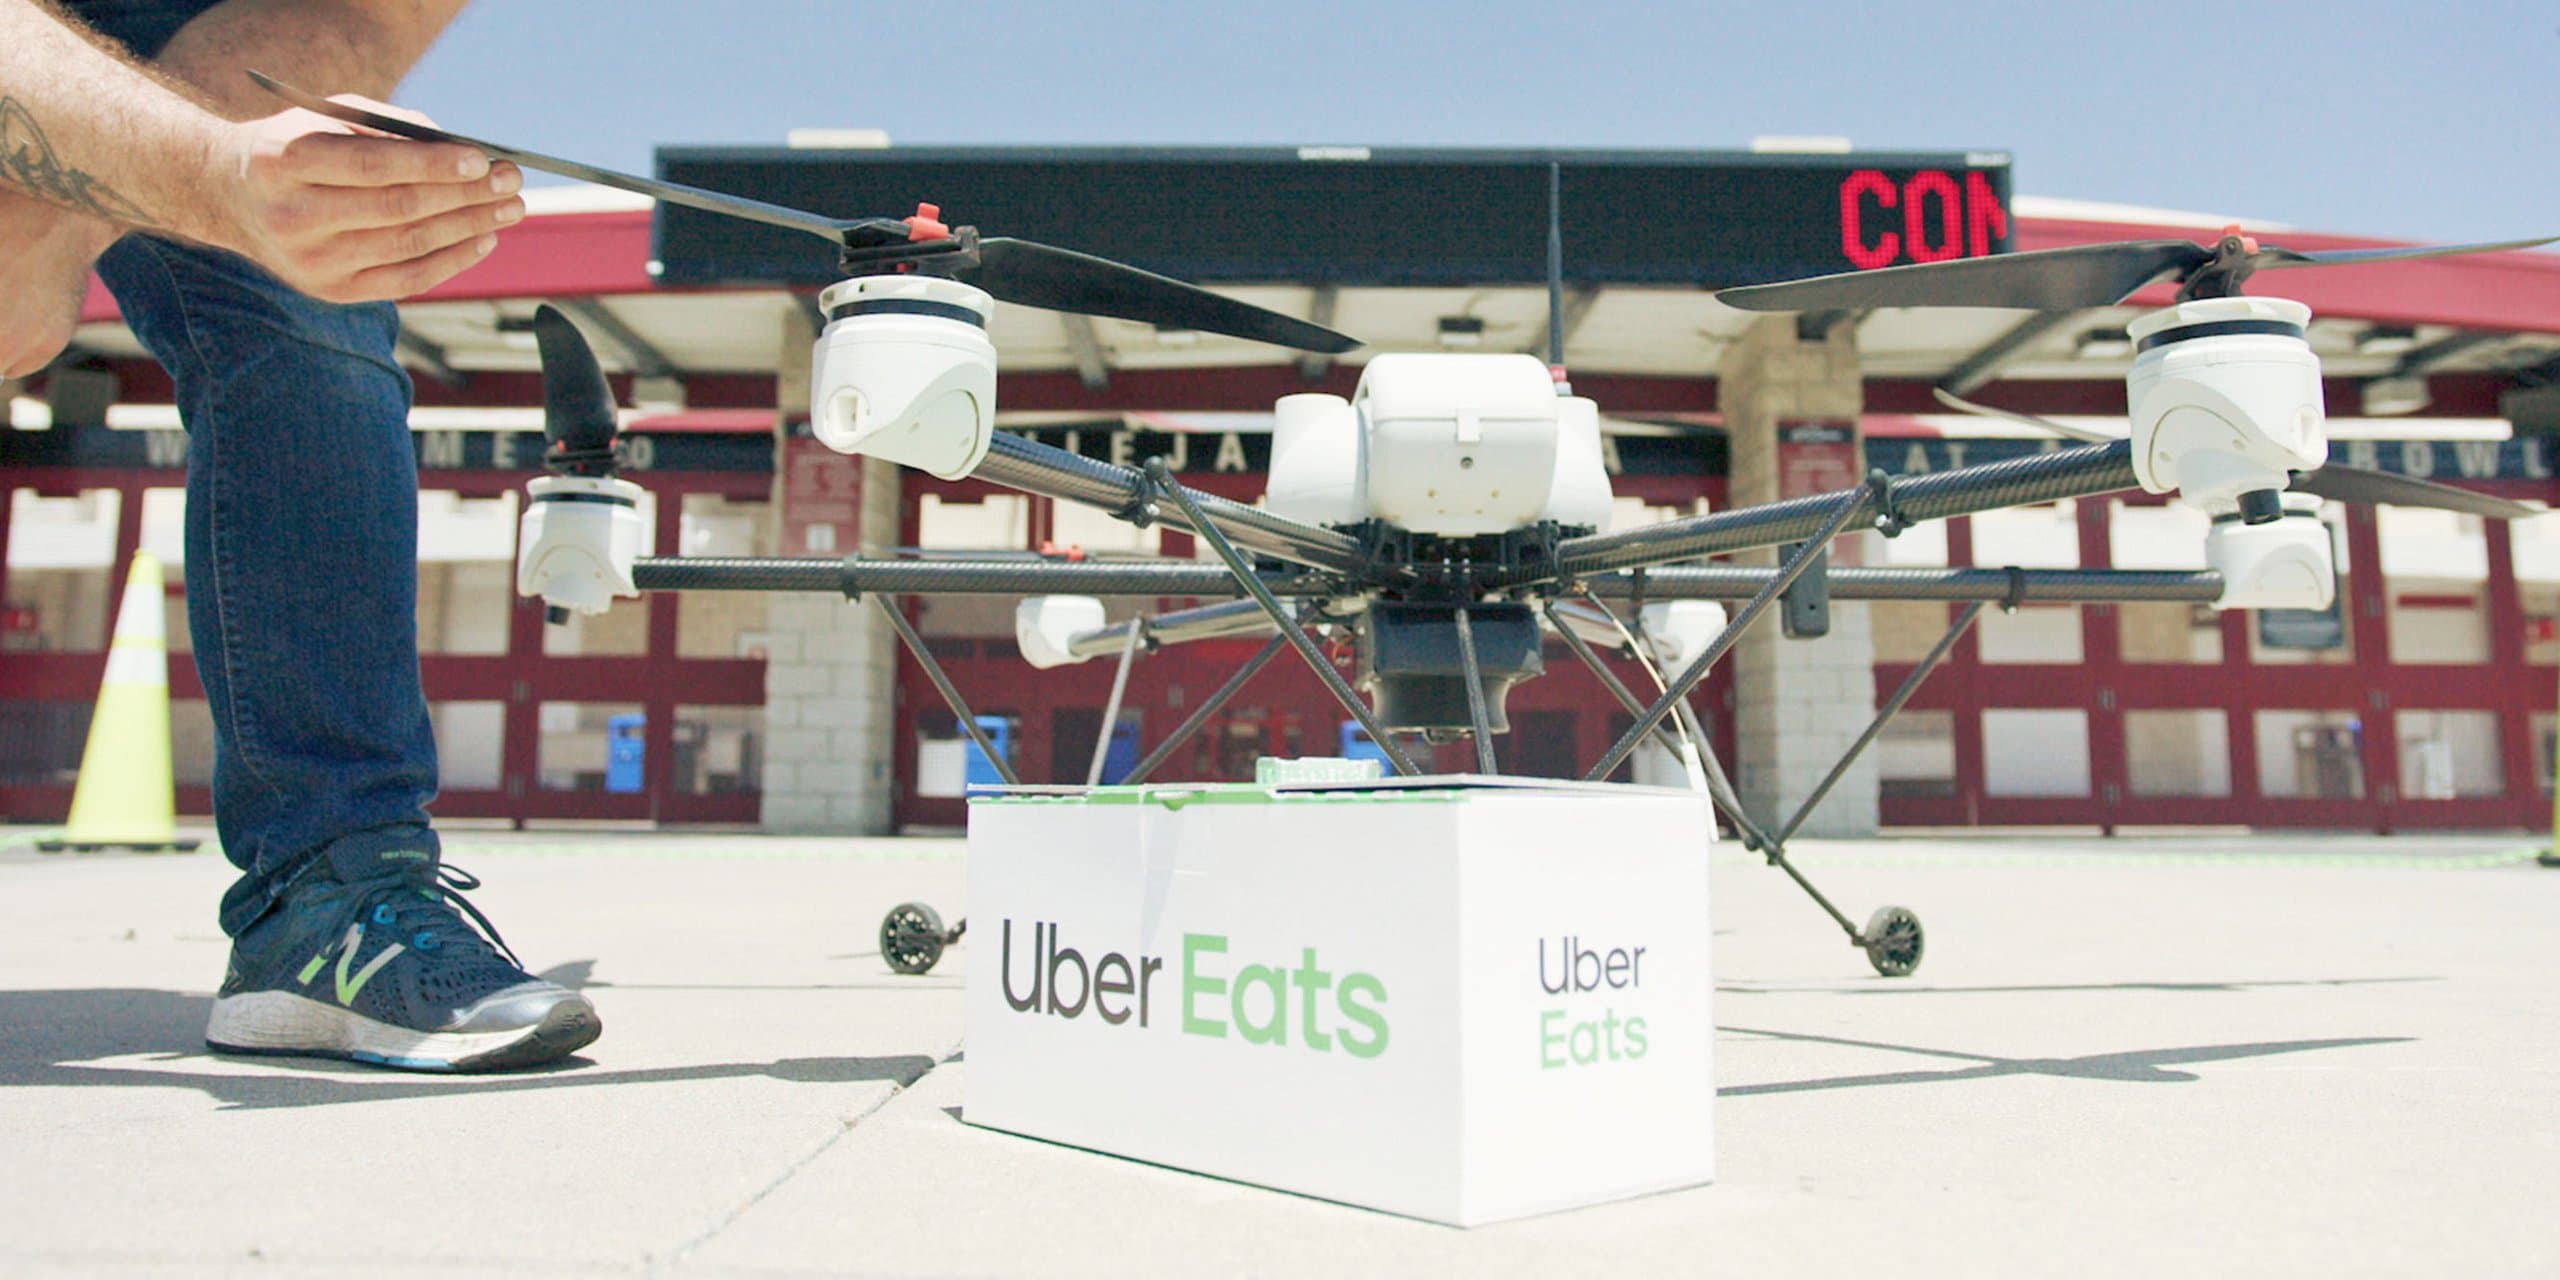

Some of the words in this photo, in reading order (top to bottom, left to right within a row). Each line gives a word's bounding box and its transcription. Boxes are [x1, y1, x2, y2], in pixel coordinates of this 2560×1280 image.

[1002, 918, 1162, 1028] Uber
[1182, 933, 1389, 1058] Eats
[1539, 935, 1646, 995] Uber
[1540, 1007, 1648, 1069] Eats
